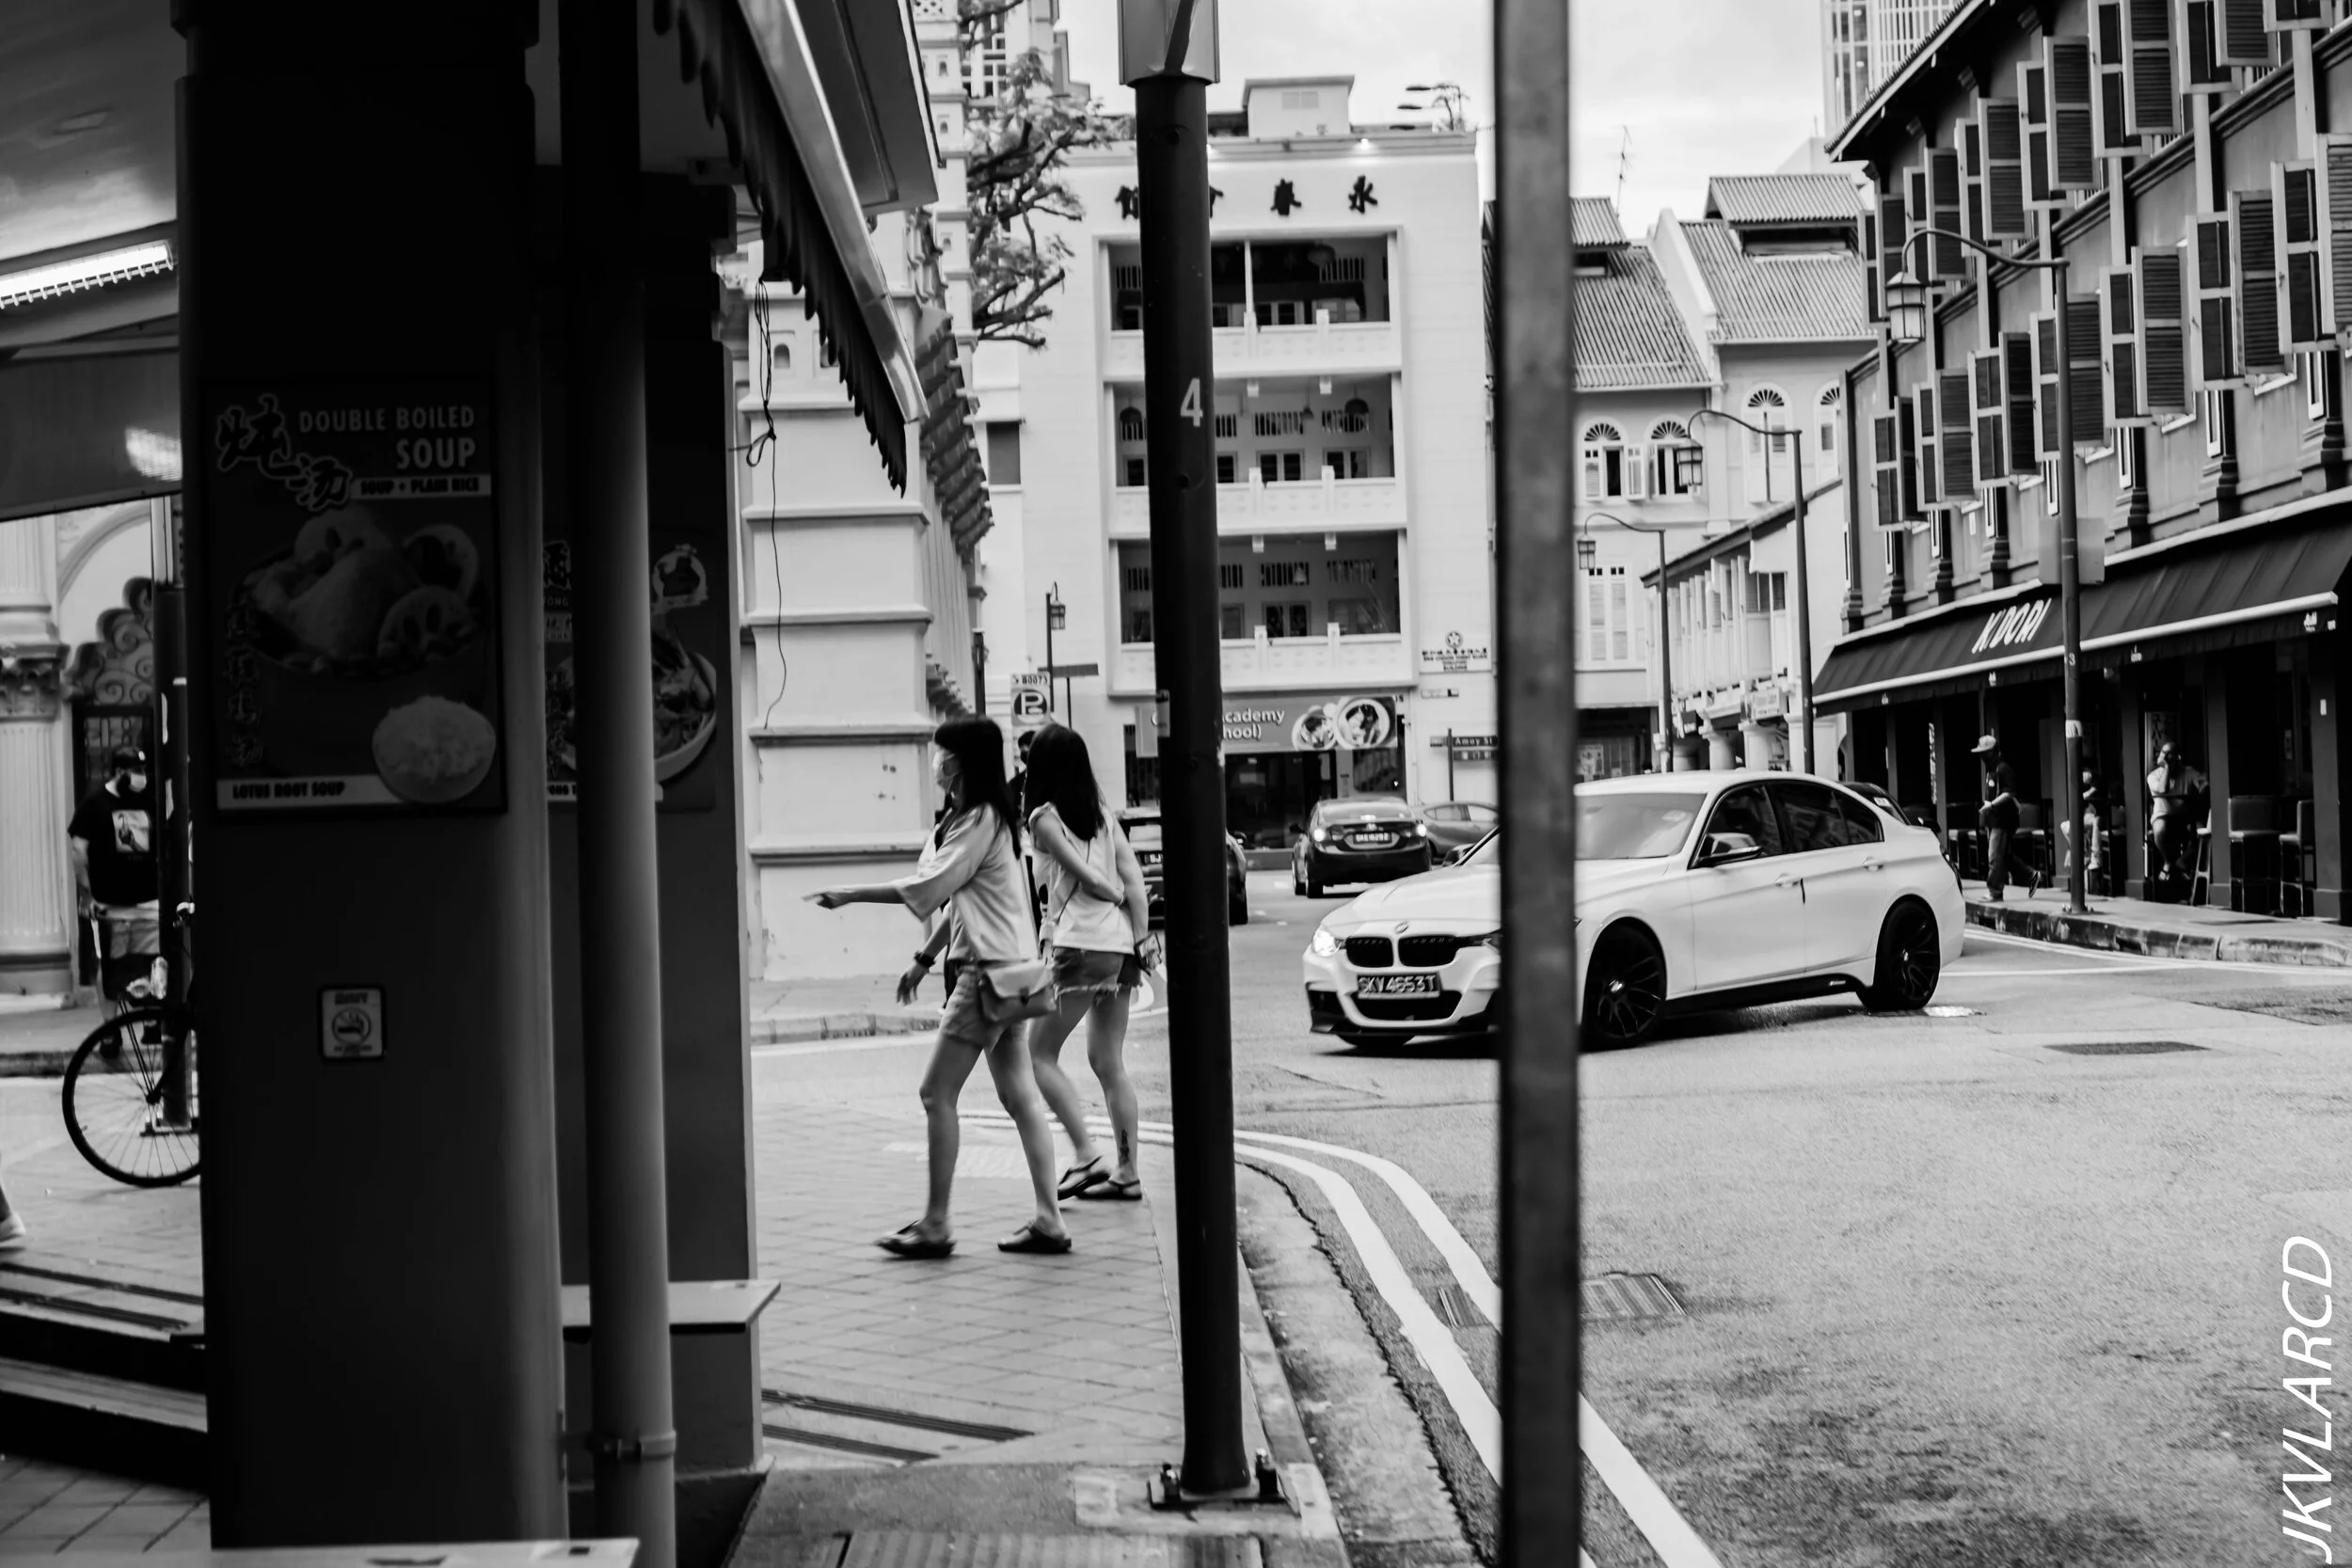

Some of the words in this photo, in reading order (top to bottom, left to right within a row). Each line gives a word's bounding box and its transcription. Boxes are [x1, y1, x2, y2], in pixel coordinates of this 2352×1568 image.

[1180, 378, 1203, 427] 4
[299, 408, 386, 433] DOUBLE
[396, 405, 474, 429] BOILED
[396, 437, 476, 469] SOUP
[360, 479, 393, 494] SOUP
[411, 478, 447, 494] PLAIN
[453, 477, 480, 492] RICE
[1222, 708, 1285, 724] cademy
[1223, 723, 1262, 741] hool)
[1455, 736, 1481, 746] Amoy
[233, 784, 270, 799] LOTUS
[275, 783, 308, 798] ROOT
[311, 782, 345, 796] SOUP
[548, 784, 569, 796] ONG
